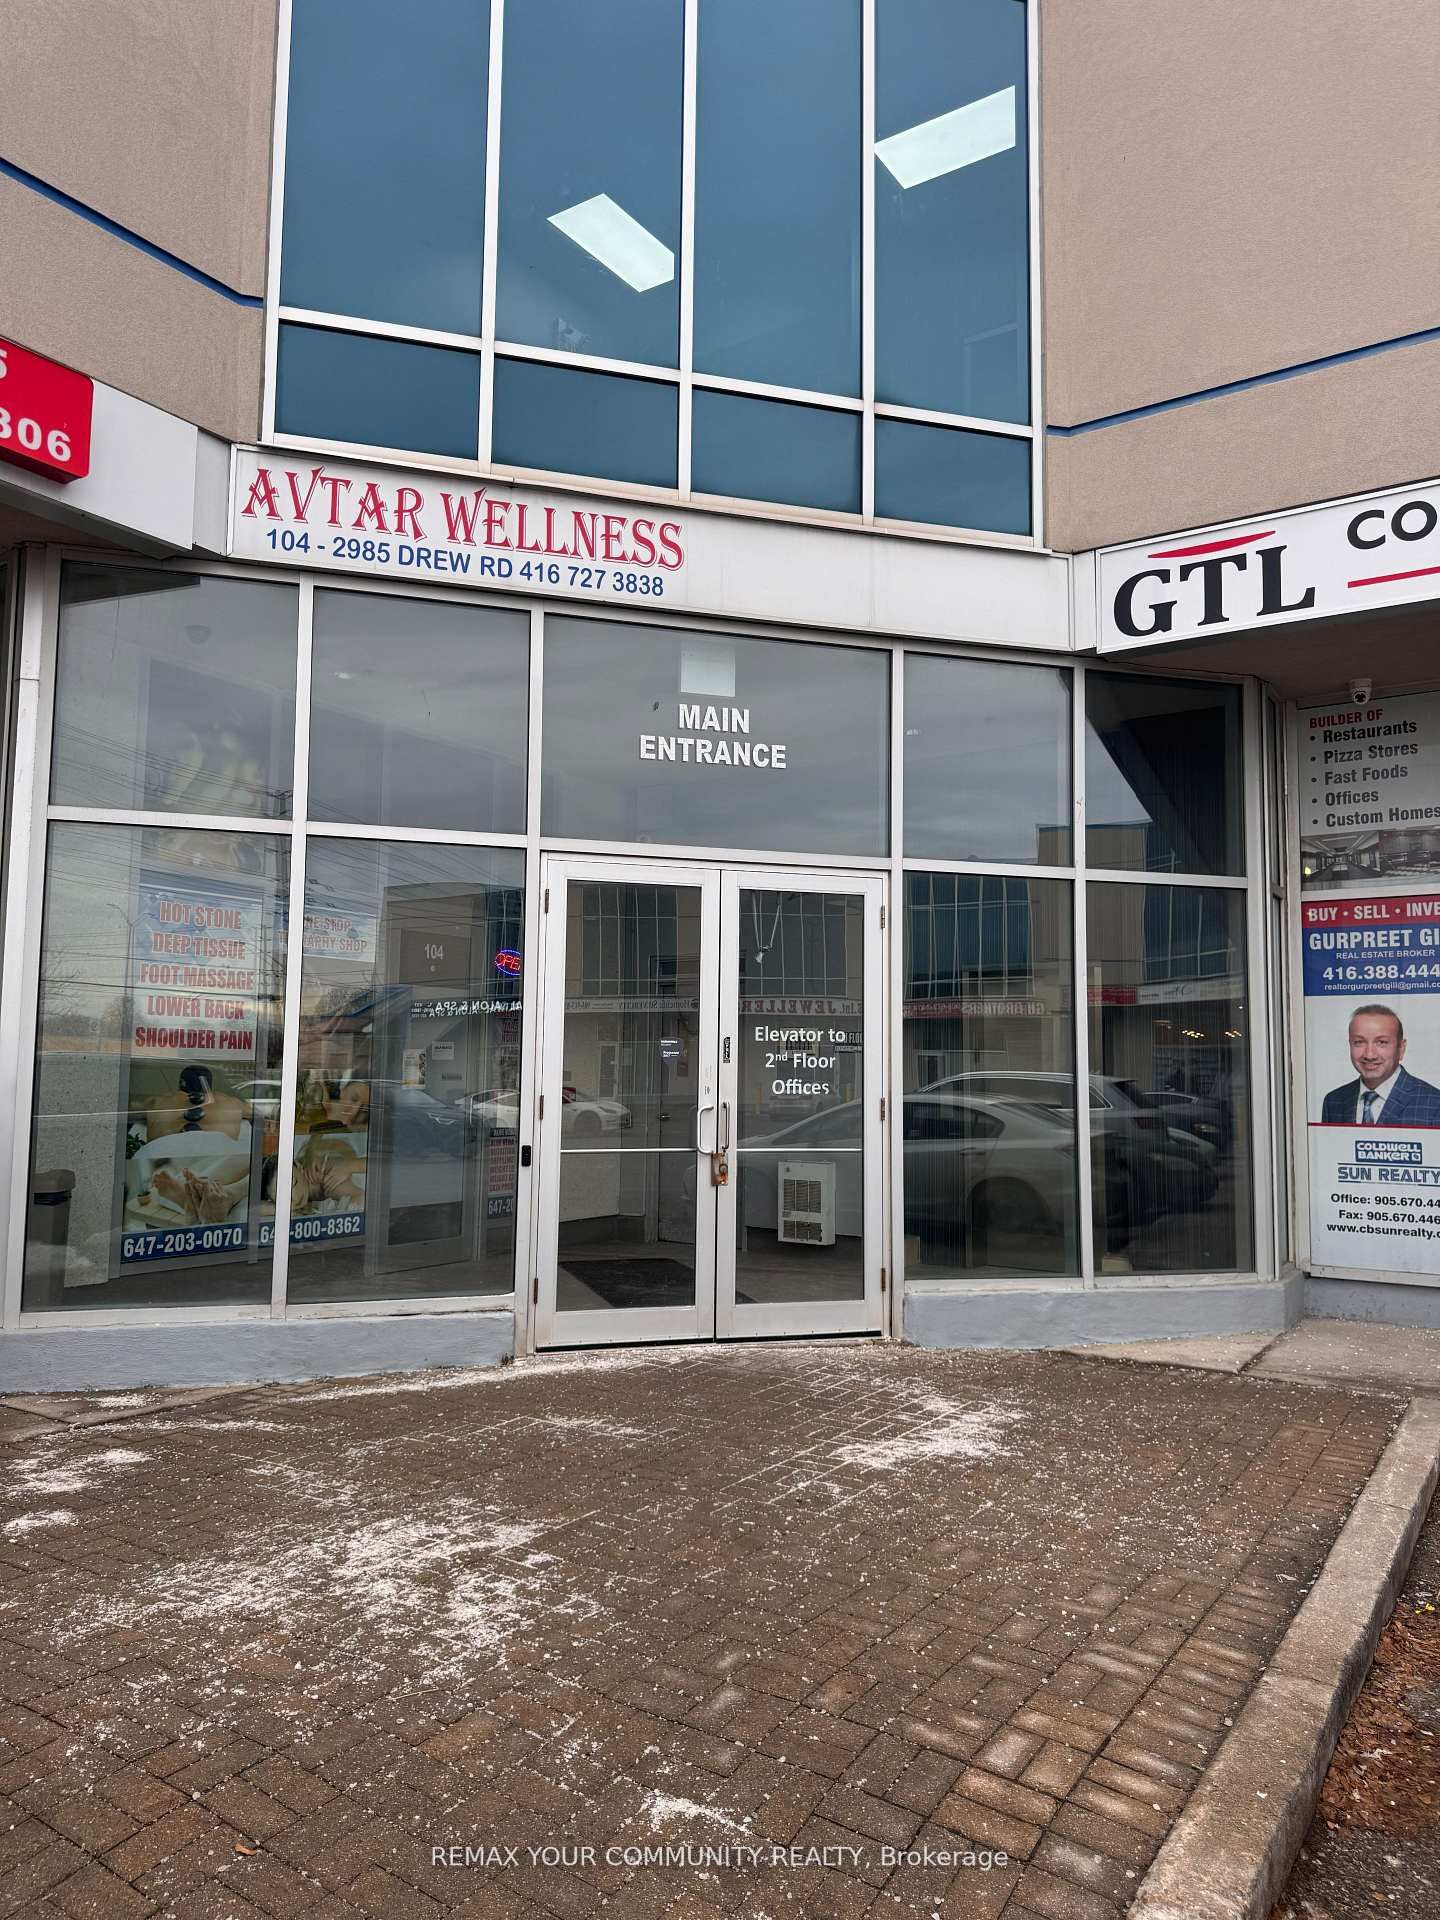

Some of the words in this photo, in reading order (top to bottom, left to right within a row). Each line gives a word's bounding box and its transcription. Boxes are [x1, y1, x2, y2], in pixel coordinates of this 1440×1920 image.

[241, 465, 428, 543] AVTAR
[440, 488, 687, 571] WELLNESS
[1346, 500, 1438, 550] CO
[267, 528, 310, 553] 104
[333, 536, 390, 563] 2985
[399, 545, 470, 573] DREW
[480, 555, 512, 578] RD
[519, 561, 560, 584] 416
[567, 566, 606, 589] 727
[612, 571, 664, 596] 3838
[1113, 545, 1315, 637] GTL
[678, 703, 750, 734] MAIN
[1309, 711, 1362, 729] BUILDER
[1367, 708, 1383, 721] OF
[1323, 720, 1417, 743] Restaurants
[639, 734, 787, 769] ENTRANCE
[1324, 749, 1362, 764] Pizza
[1368, 743, 1418, 759] Stores
[1325, 769, 1357, 785] Fast
[1362, 764, 1408, 781] Foods
[1325, 790, 1379, 806] Offices
[1326, 811, 1383, 827] Custom
[1388, 806, 1440, 822] Homes
[159, 901, 192, 925] HOT
[194, 906, 241, 930] STONE
[1308, 907, 1338, 921] BUY
[1354, 904, 1390, 919] SELL
[1406, 901, 1440, 917] INVE
[152, 932, 191, 955] DEEP
[192, 936, 246, 960] TISSUE
[1309, 929, 1412, 950] GURPREET
[1419, 928, 1440, 946] GI
[424, 943, 443, 960] 104
[1336, 952, 1359, 960] REAL
[1361, 950, 1394, 959] ESTATE
[1397, 949, 1435, 958] BROKER
[139, 963, 180, 985] FOOT
[182, 966, 257, 991] MASSAGE
[1322, 964, 1440, 981] 416.388.444
[147, 996, 200, 1017] LOWER
[204, 999, 245, 1020] BACK
[135, 1026, 216, 1049] SHOULDER
[219, 1030, 253, 1050] PAIN
[754, 1026, 825, 1042] Elevator
[827, 1028, 846, 1042] to
[765, 1052, 788, 1068] 2nd
[793, 1053, 836, 1068] Floor
[772, 1079, 830, 1096] Offices
[1337, 1167, 1372, 1181] SUN
[1378, 1168, 1440, 1184] REALTY
[1331, 1193, 1371, 1204] Office:
[1338, 1209, 1363, 1220] Fax:
[260, 1216, 361, 1243] 64-800-8362
[123, 1227, 243, 1258] 647-203-0070
